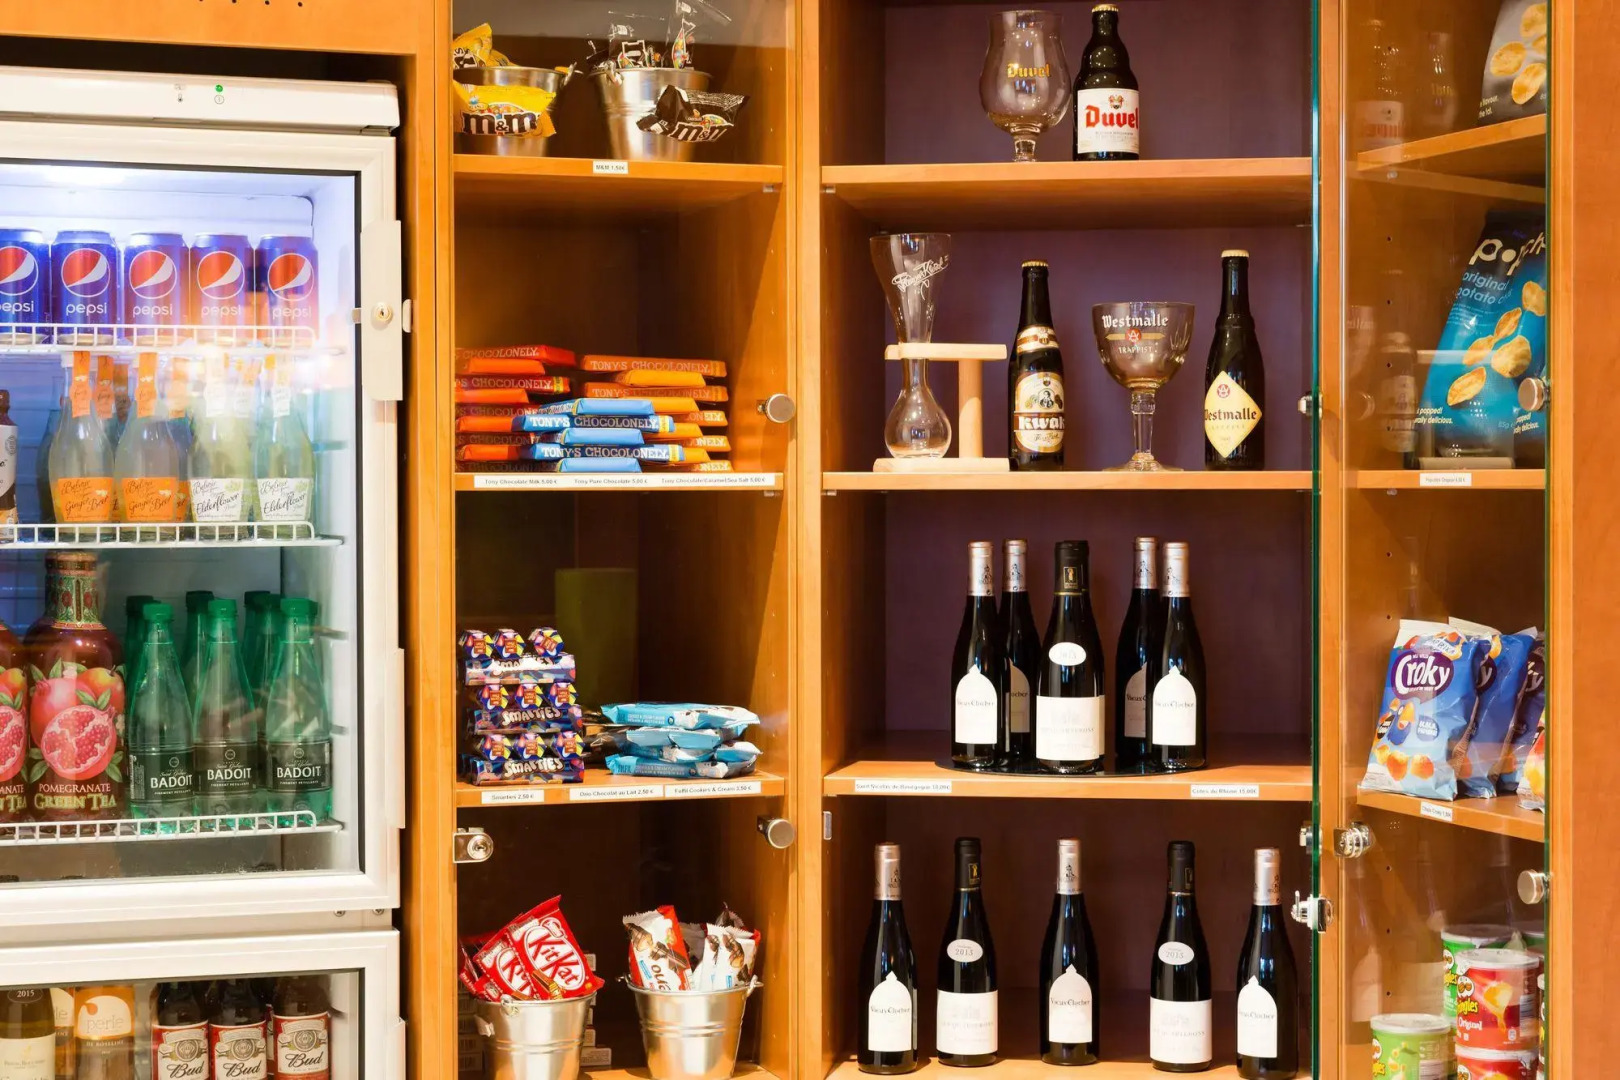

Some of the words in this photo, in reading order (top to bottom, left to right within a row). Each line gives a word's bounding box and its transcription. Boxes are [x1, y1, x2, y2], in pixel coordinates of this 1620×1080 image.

[1007, 63, 1050, 78] Duvel
[1085, 104, 1138, 129] Duvel
[66, 302, 107, 316] pepsi
[133, 304, 173, 318] pepsi
[201, 304, 241, 318] pepsi
[272, 306, 312, 320] pepsi
[1102, 313, 1169, 328] Westmalle
[530, 417, 570, 428] TONY'S
[541, 446, 581, 458] TONY'S
[196, 493, 240, 515] Elderflower
[263, 492, 306, 515] Elderflower
[1395, 654, 1450, 695] Croky
[207, 767, 252, 780] BADOIT
[277, 766, 321, 778] BADOIT
[39, 783, 111, 793] POMEGRANATE
[151, 774, 193, 789] BADOIT
[34, 793, 86, 809] GREEN
[87, 792, 117, 810] TEA
[17, 989, 35, 998] 2015
[87, 1013, 124, 1034] perle
[285, 1052, 324, 1068] Bud
[167, 1061, 204, 1079] Bud
[223, 1061, 262, 1078] Bud
